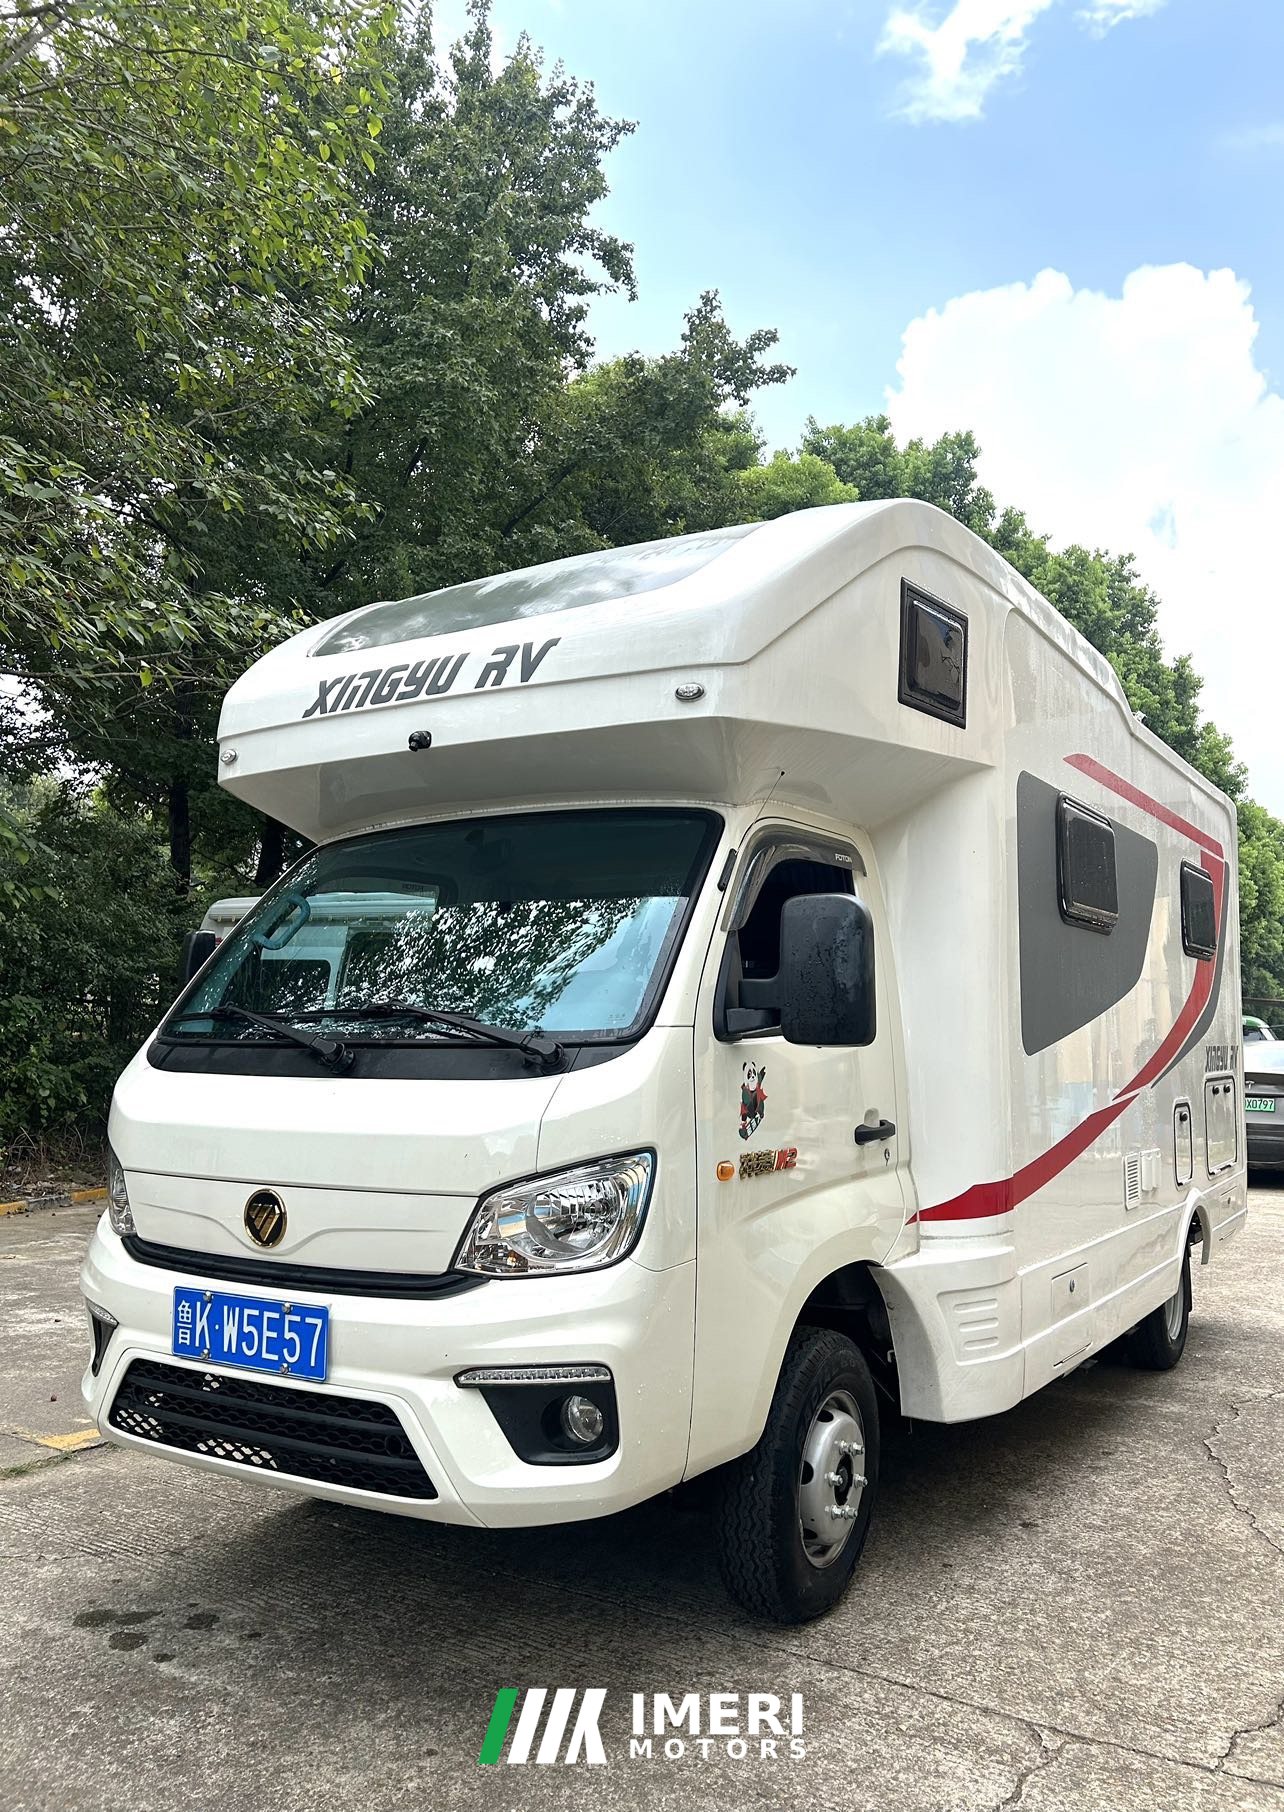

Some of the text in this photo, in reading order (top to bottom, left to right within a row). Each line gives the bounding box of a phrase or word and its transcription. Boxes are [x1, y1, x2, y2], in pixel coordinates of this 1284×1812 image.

[302, 637, 562, 719] XINGYU RV
[1205, 1045, 1239, 1072] XINGYU RV
[1245, 1099, 1274, 1110] X0797
